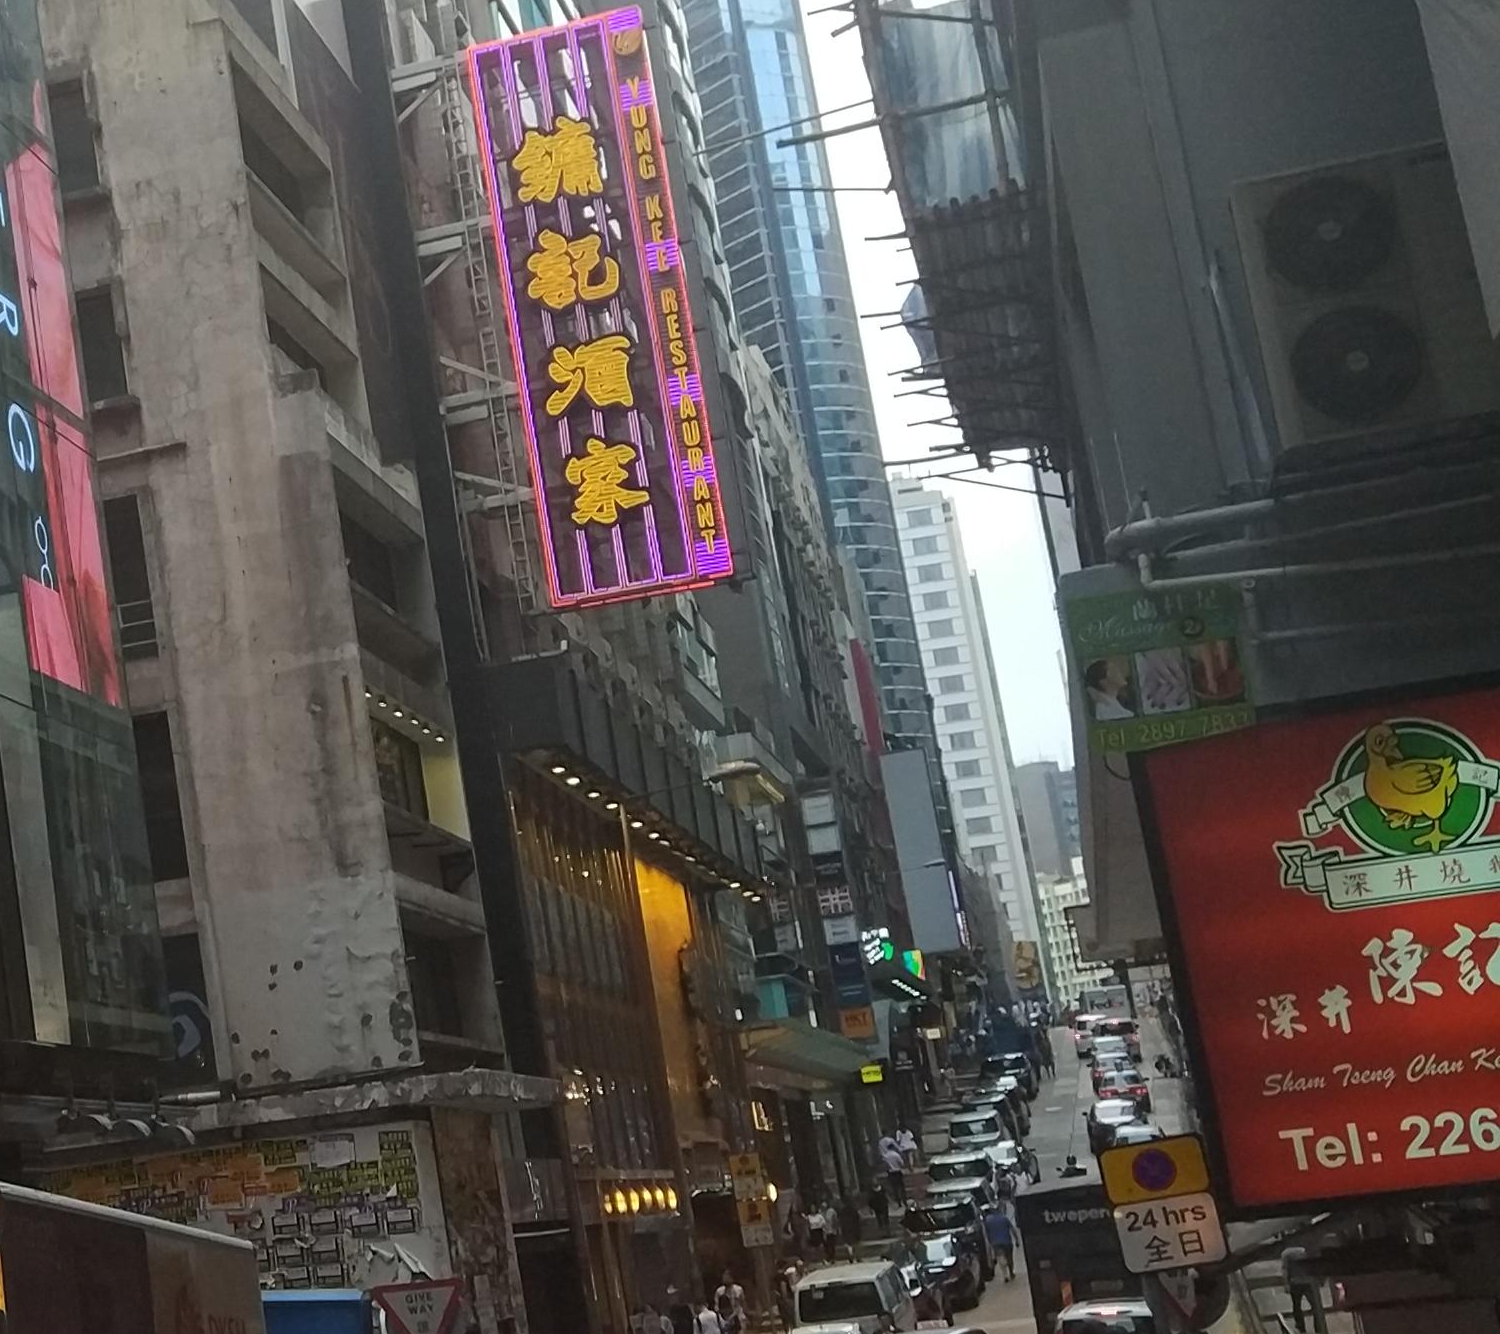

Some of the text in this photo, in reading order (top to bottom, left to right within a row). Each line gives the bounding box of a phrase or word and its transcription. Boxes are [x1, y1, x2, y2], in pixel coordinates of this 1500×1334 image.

[512, 117, 651, 526] 鏞記酒家
[625, 76, 721, 553] YUNG KEE RESTAURANT
[1099, 727, 1125, 747] Tel
[1138, 721, 1187, 743] 2897
[1262, 1070, 1326, 1097] Sham
[1332, 1063, 1396, 1089] Tseng
[1406, 1052, 1465, 1083] Chan
[1278, 1107, 1500, 1171] Tel: 226
[1124, 1205, 1207, 1233] 24 hrs
[1144, 1228, 1206, 1265] 全日
[404, 1292, 434, 1304] GIVE
[406, 1303, 435, 1316] WAY
